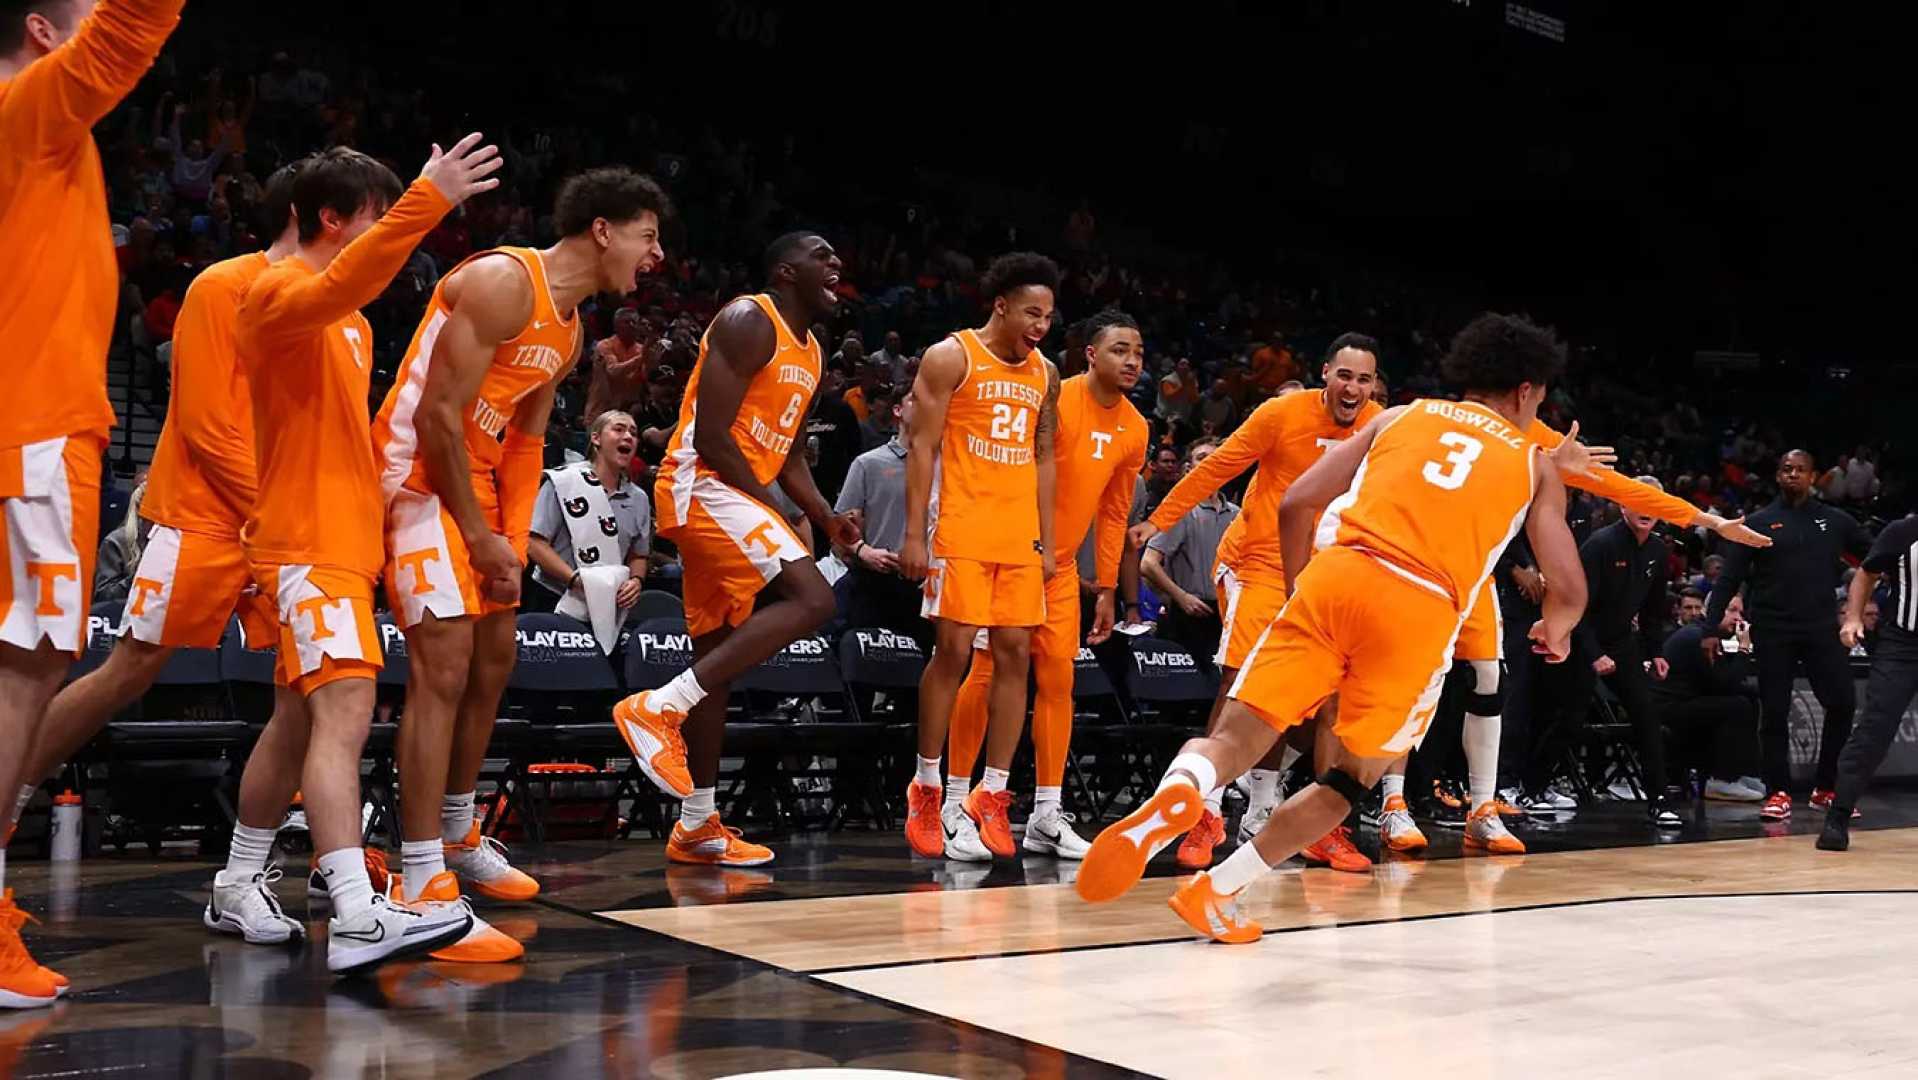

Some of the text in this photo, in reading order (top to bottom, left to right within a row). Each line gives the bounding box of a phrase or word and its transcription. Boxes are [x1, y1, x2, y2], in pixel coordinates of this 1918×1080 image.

[780, 392, 802, 429] 6
[991, 403, 1029, 443] 24
[1425, 402, 1525, 449] BOSWELL
[1090, 431, 1112, 460] T
[1422, 431, 1484, 490] 3
[741, 520, 781, 558] T
[26, 562, 77, 617] T
[398, 547, 440, 596] T
[129, 577, 164, 616] T
[295, 597, 341, 642] T
[1133, 651, 1195, 675] PLAYERS
